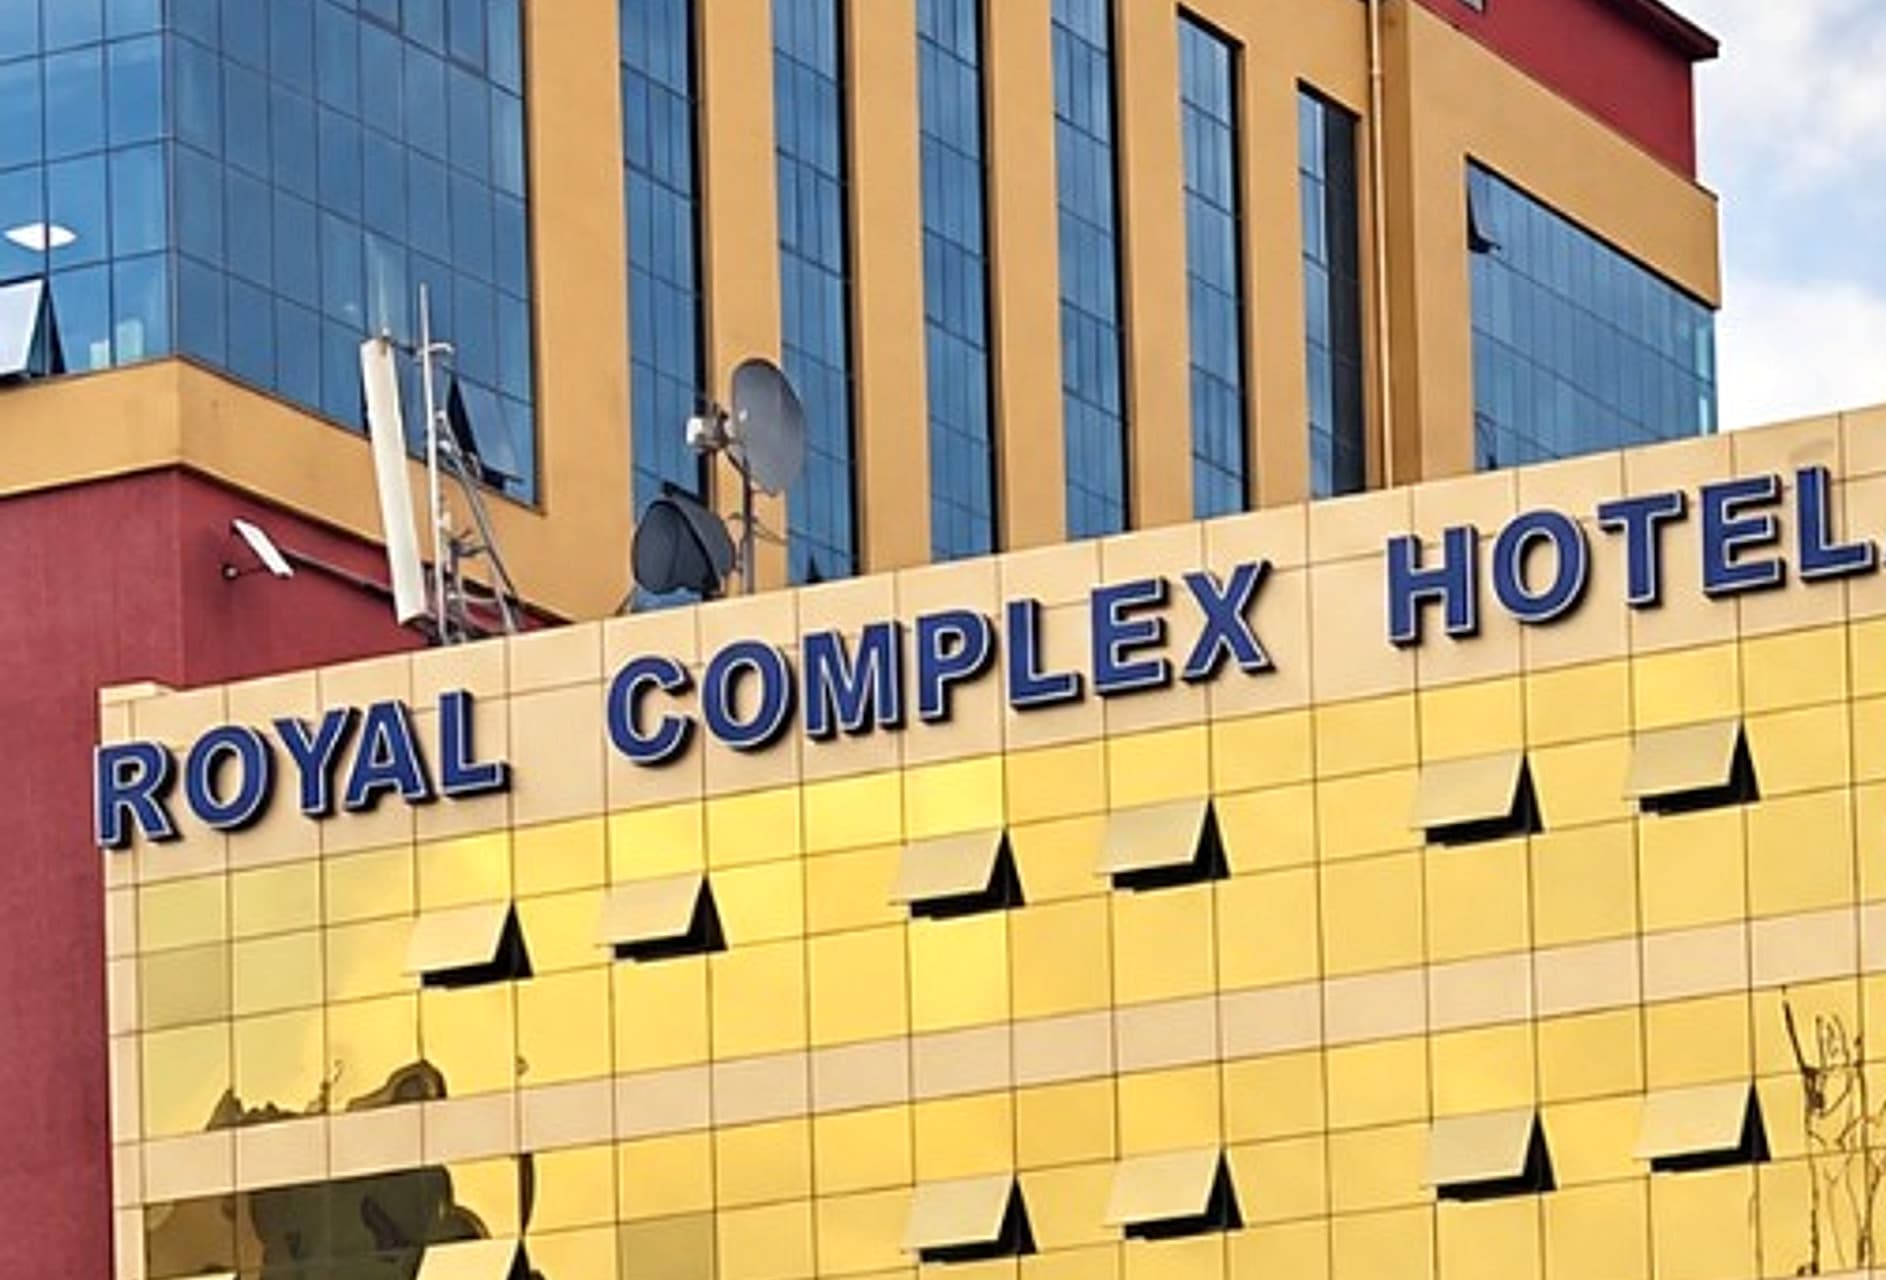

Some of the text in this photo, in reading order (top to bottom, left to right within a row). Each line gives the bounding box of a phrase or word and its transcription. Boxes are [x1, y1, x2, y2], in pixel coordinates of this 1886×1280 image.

[94, 465, 1875, 849] ROYAL COMPLEX HOTEL
